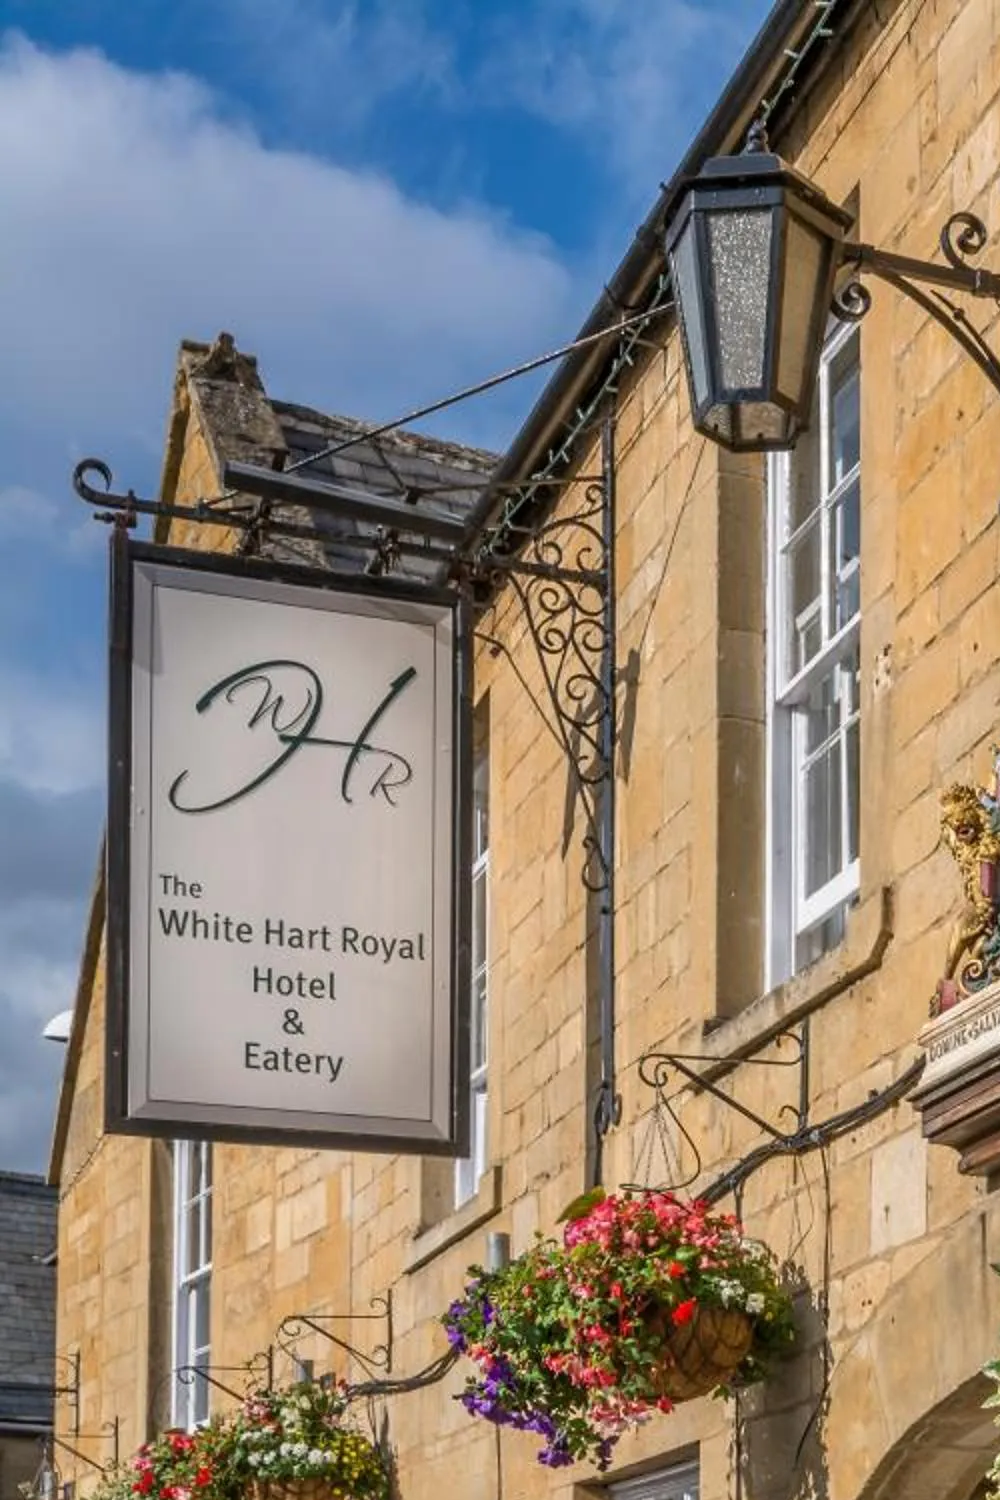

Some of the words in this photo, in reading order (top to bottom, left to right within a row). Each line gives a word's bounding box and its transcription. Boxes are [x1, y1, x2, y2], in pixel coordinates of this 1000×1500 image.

[159, 872, 203, 900] The
[158, 908, 254, 946] White
[264, 919, 332, 953] Hart
[342, 926, 426, 965] Royal
[252, 966, 337, 1001] Hotel
[282, 1008, 305, 1036] &
[244, 1042, 344, 1083] Eatery
